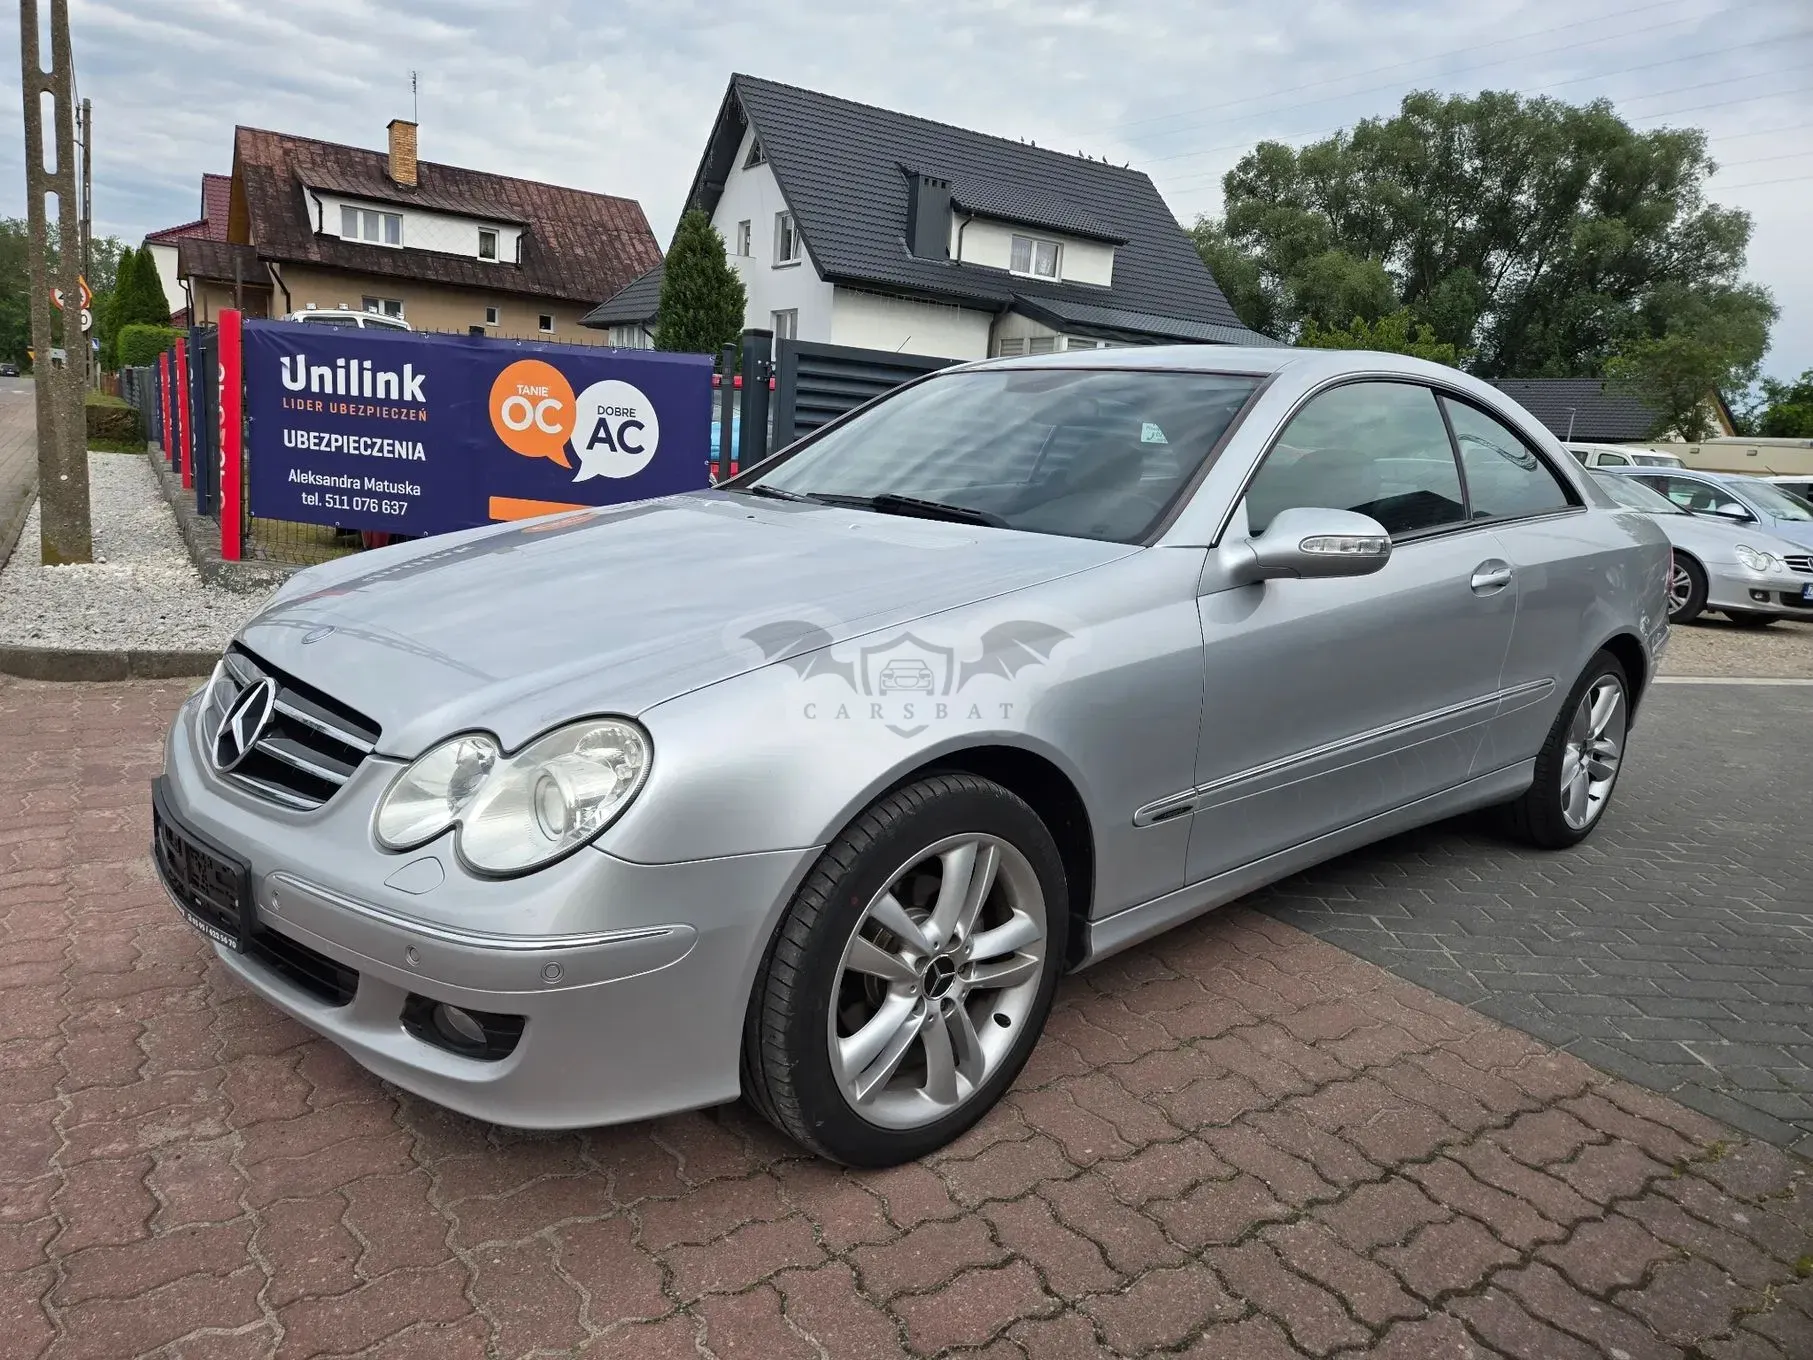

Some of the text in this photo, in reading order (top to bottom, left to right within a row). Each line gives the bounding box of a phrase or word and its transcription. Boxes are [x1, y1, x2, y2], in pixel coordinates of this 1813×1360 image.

[280, 354, 427, 403] Unilink
[516, 384, 550, 397] TANIE
[283, 397, 427, 422] LIDER UBEZPIECZEŃ
[501, 395, 563, 434] OC
[597, 405, 636, 418] DOBRE
[283, 429, 426, 461] UBEZPIECZENIA
[586, 416, 646, 455] AC
[288, 468, 421, 496] Aleksandra Matuska
[301, 491, 408, 516] tel. 511 076 637
